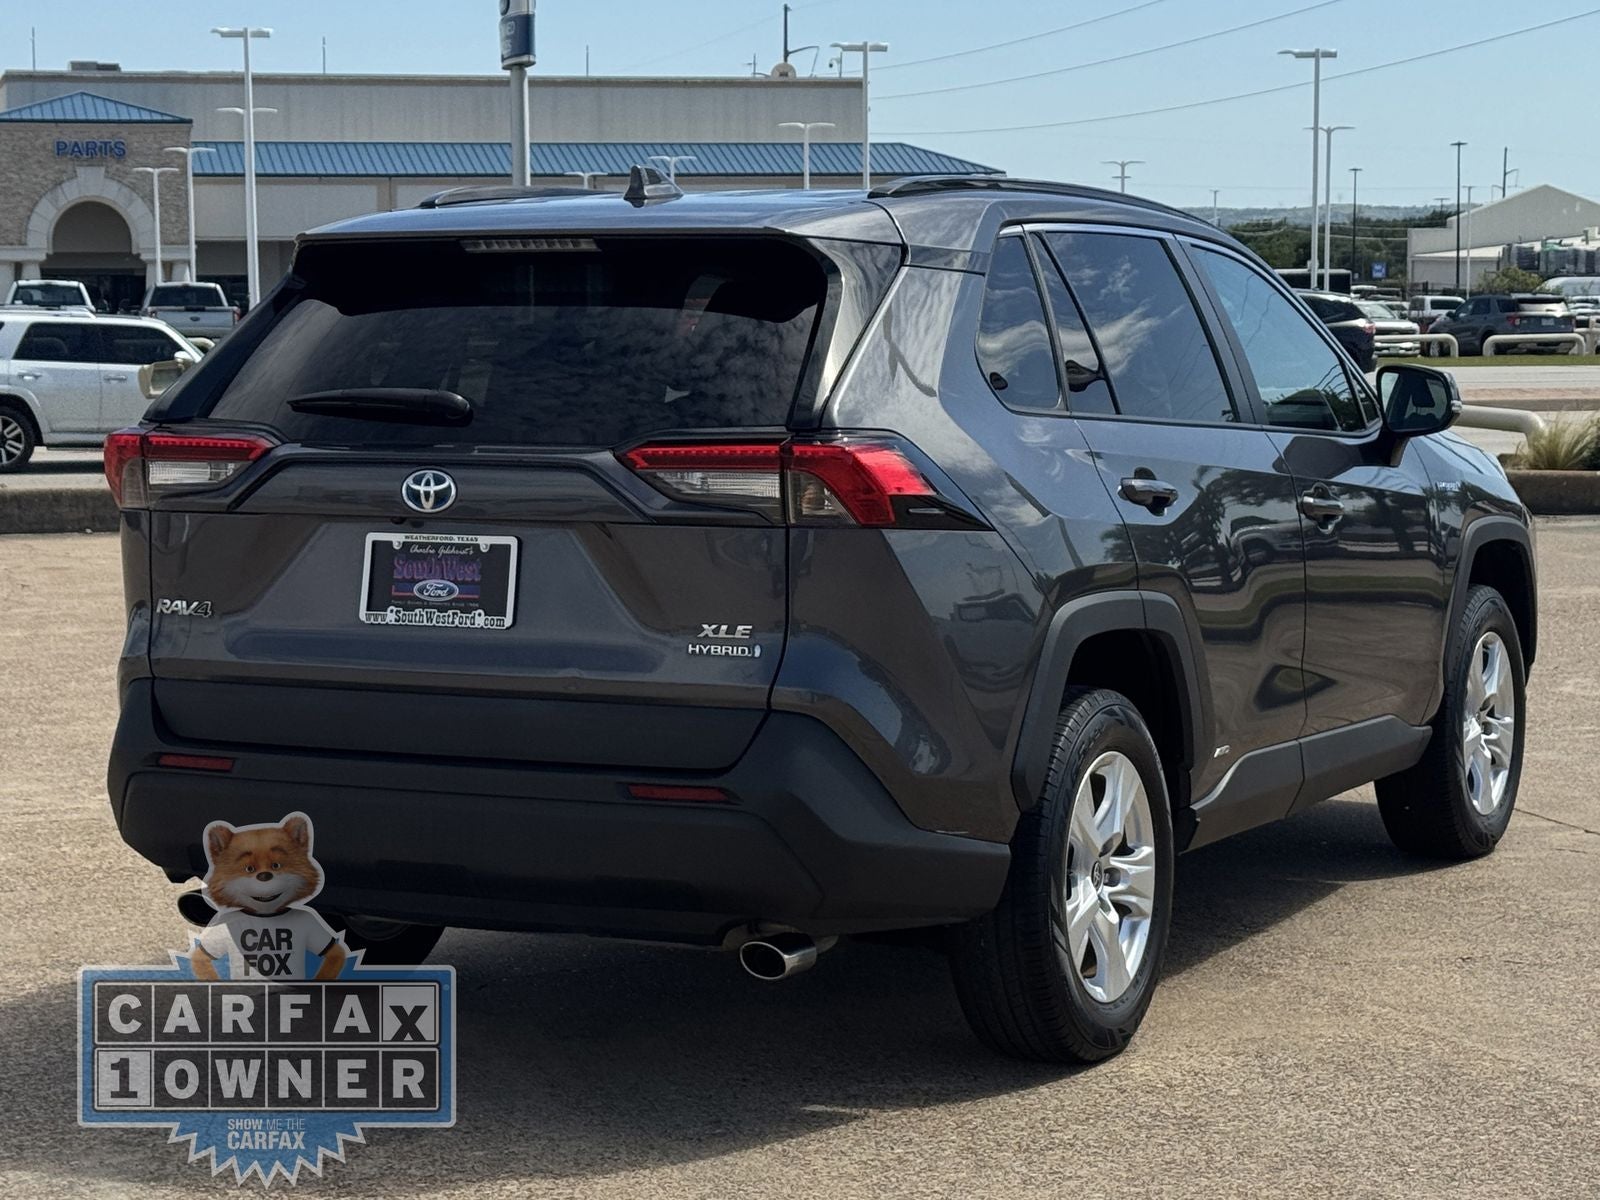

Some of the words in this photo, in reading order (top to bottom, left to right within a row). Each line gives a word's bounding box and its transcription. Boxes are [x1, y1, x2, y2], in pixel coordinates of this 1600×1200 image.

[55, 140, 127, 157] PARTS
[423, 583, 449, 597] Ford
[156, 598, 212, 618] RAV4
[697, 623, 753, 638] XLE
[688, 643, 751, 657] HYBRID
